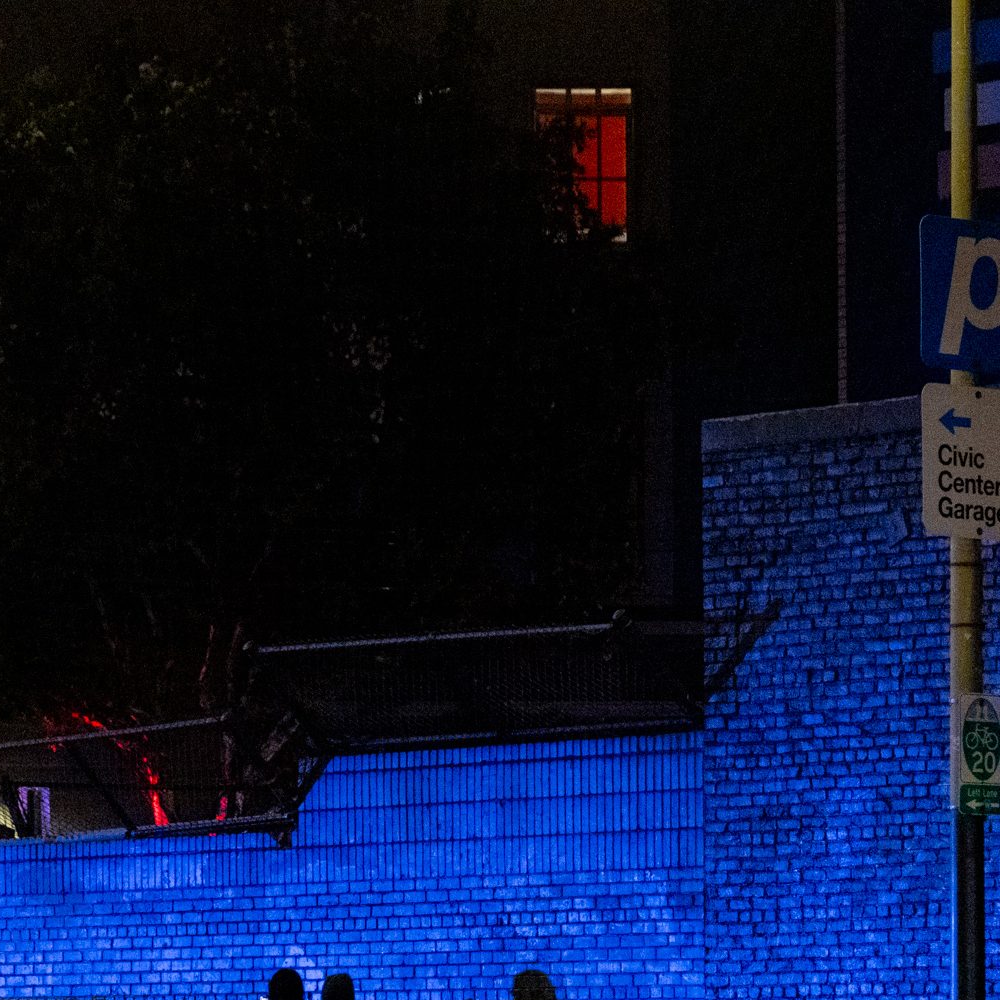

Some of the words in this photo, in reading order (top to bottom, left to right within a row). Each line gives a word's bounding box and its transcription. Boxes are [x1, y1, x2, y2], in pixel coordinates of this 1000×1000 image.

[938, 443, 985, 469] Civic
[938, 470, 1000, 496] Center
[972, 750, 996, 774] 20
